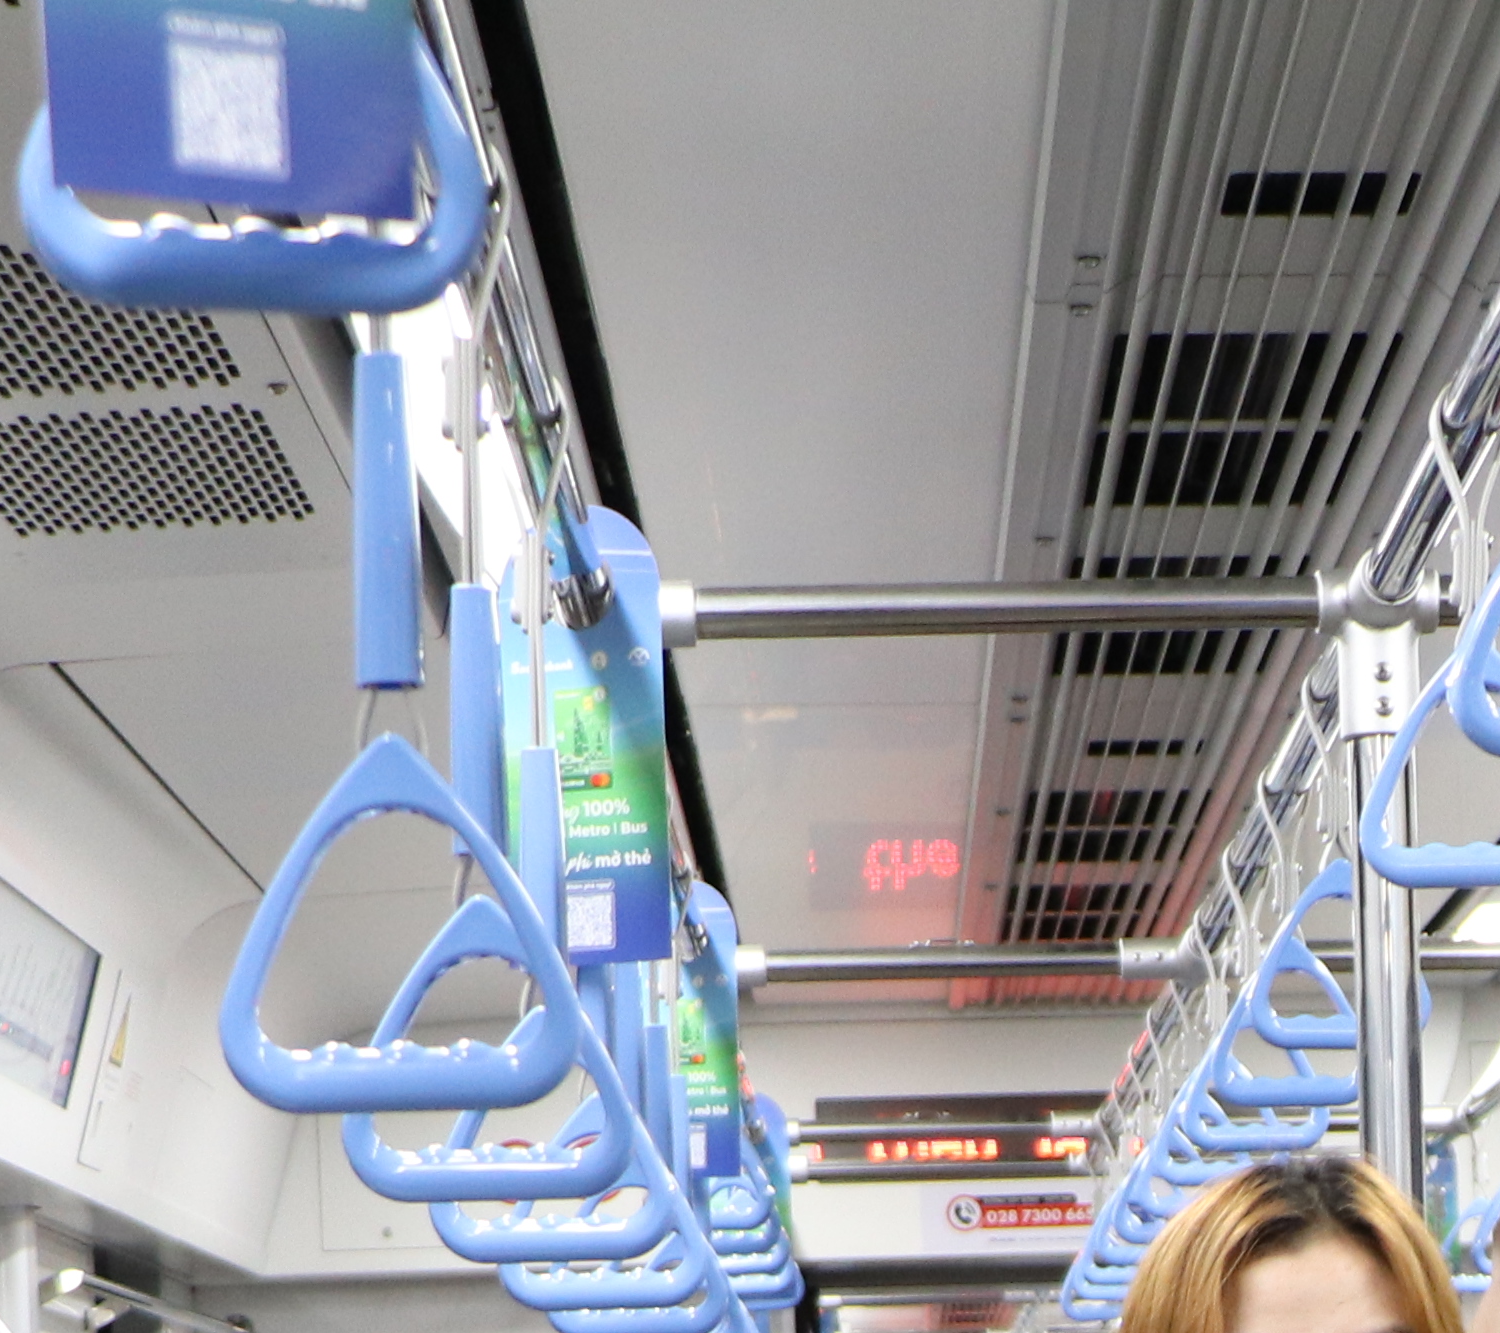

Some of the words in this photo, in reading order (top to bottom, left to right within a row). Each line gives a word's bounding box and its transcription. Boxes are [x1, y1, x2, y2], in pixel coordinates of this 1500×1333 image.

[583, 798, 630, 817] 100%
[569, 825, 611, 838] Metro
[621, 821, 648, 834] Bus
[986, 1209, 1018, 1224] 028
[1022, 1207, 1062, 1223] 7300
[1065, 1206, 1094, 1221] 665
